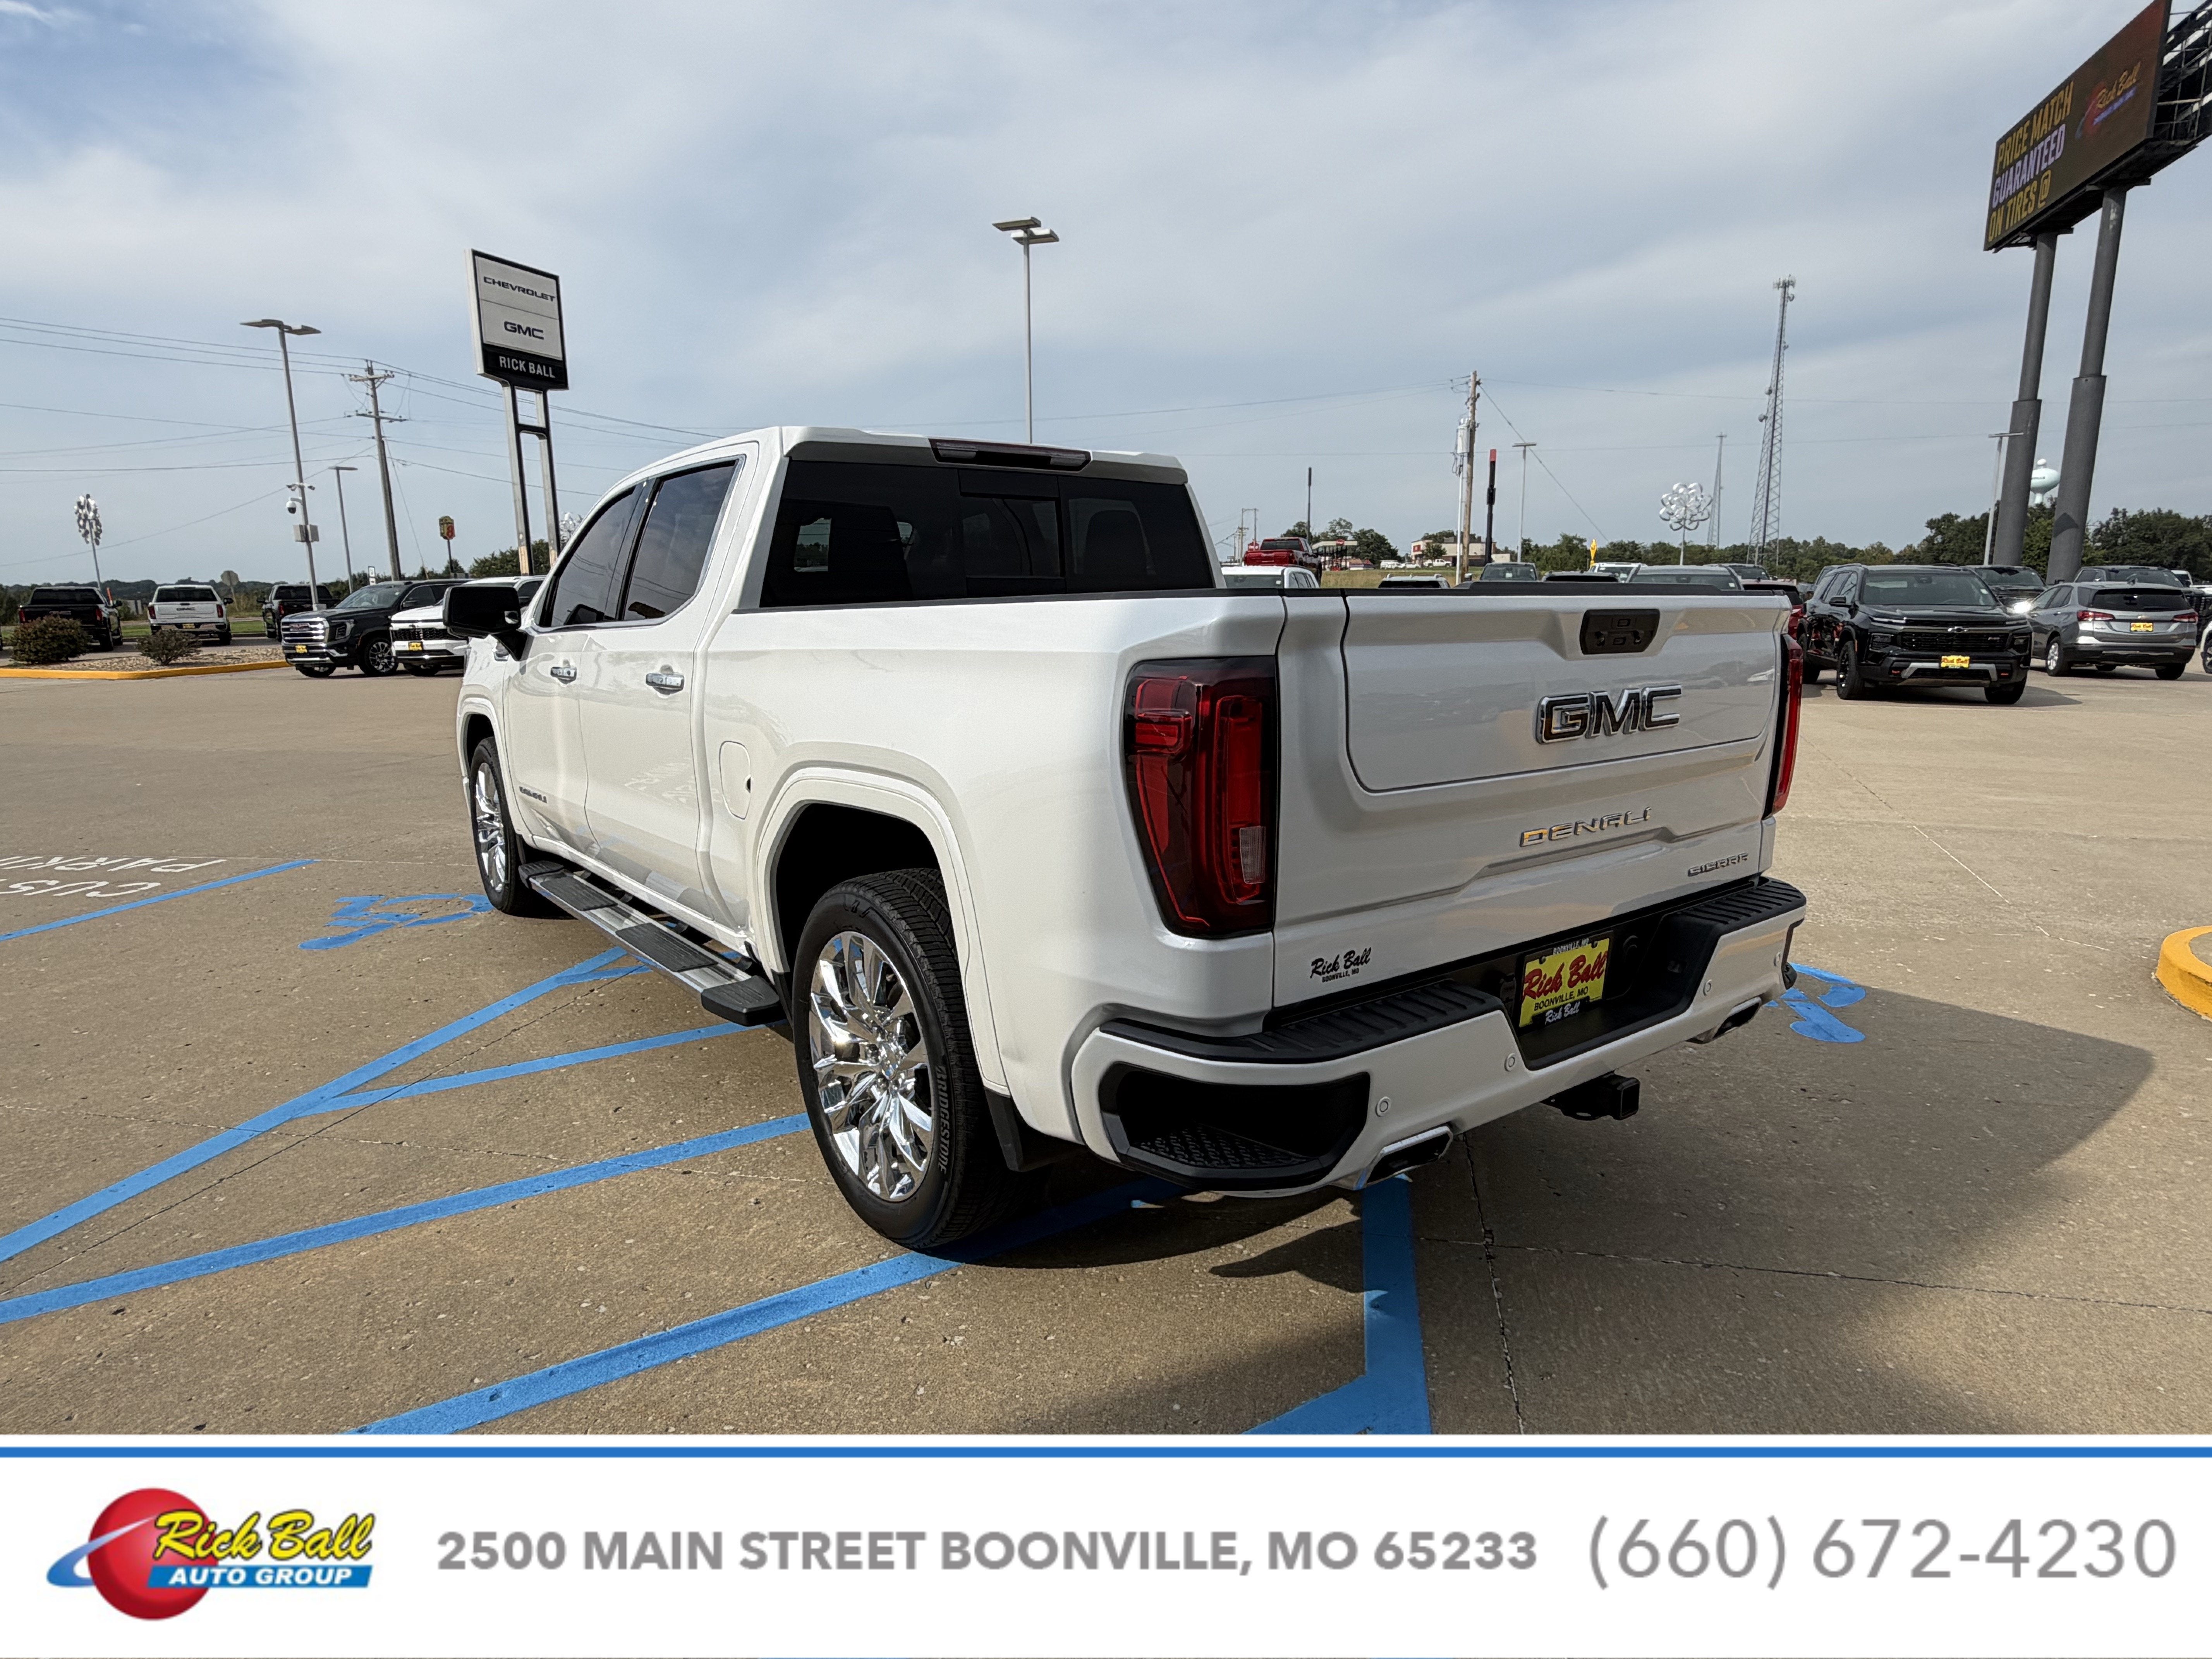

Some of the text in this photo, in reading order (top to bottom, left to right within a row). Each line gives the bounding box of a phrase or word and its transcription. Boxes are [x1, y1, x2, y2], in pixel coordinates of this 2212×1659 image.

[1996, 120, 2030, 175] PRICE
[2030, 81, 2074, 146] MATCH
[1992, 124, 2066, 208] GUARANTEED
[1988, 170, 2051, 242] ON TIRES @
[483, 276, 555, 301] CHEVROLET
[504, 321, 544, 340] GMC
[499, 356, 555, 378] RICK BALL
[1535, 683, 1681, 744] GMC
[1520, 806, 1652, 847] DENALI
[1688, 852, 1748, 877] SIERRA
[0, 879, 161, 897] CUS
[1310, 947, 1371, 979] Rick Ball
[1523, 951, 1609, 1000] Rick Ball
[1534, 986, 1589, 1011] BOONVILLE, MO
[1545, 1001, 1580, 1025] Rick Ball
[935, 1066, 949, 1174] BRIDGESTONE
